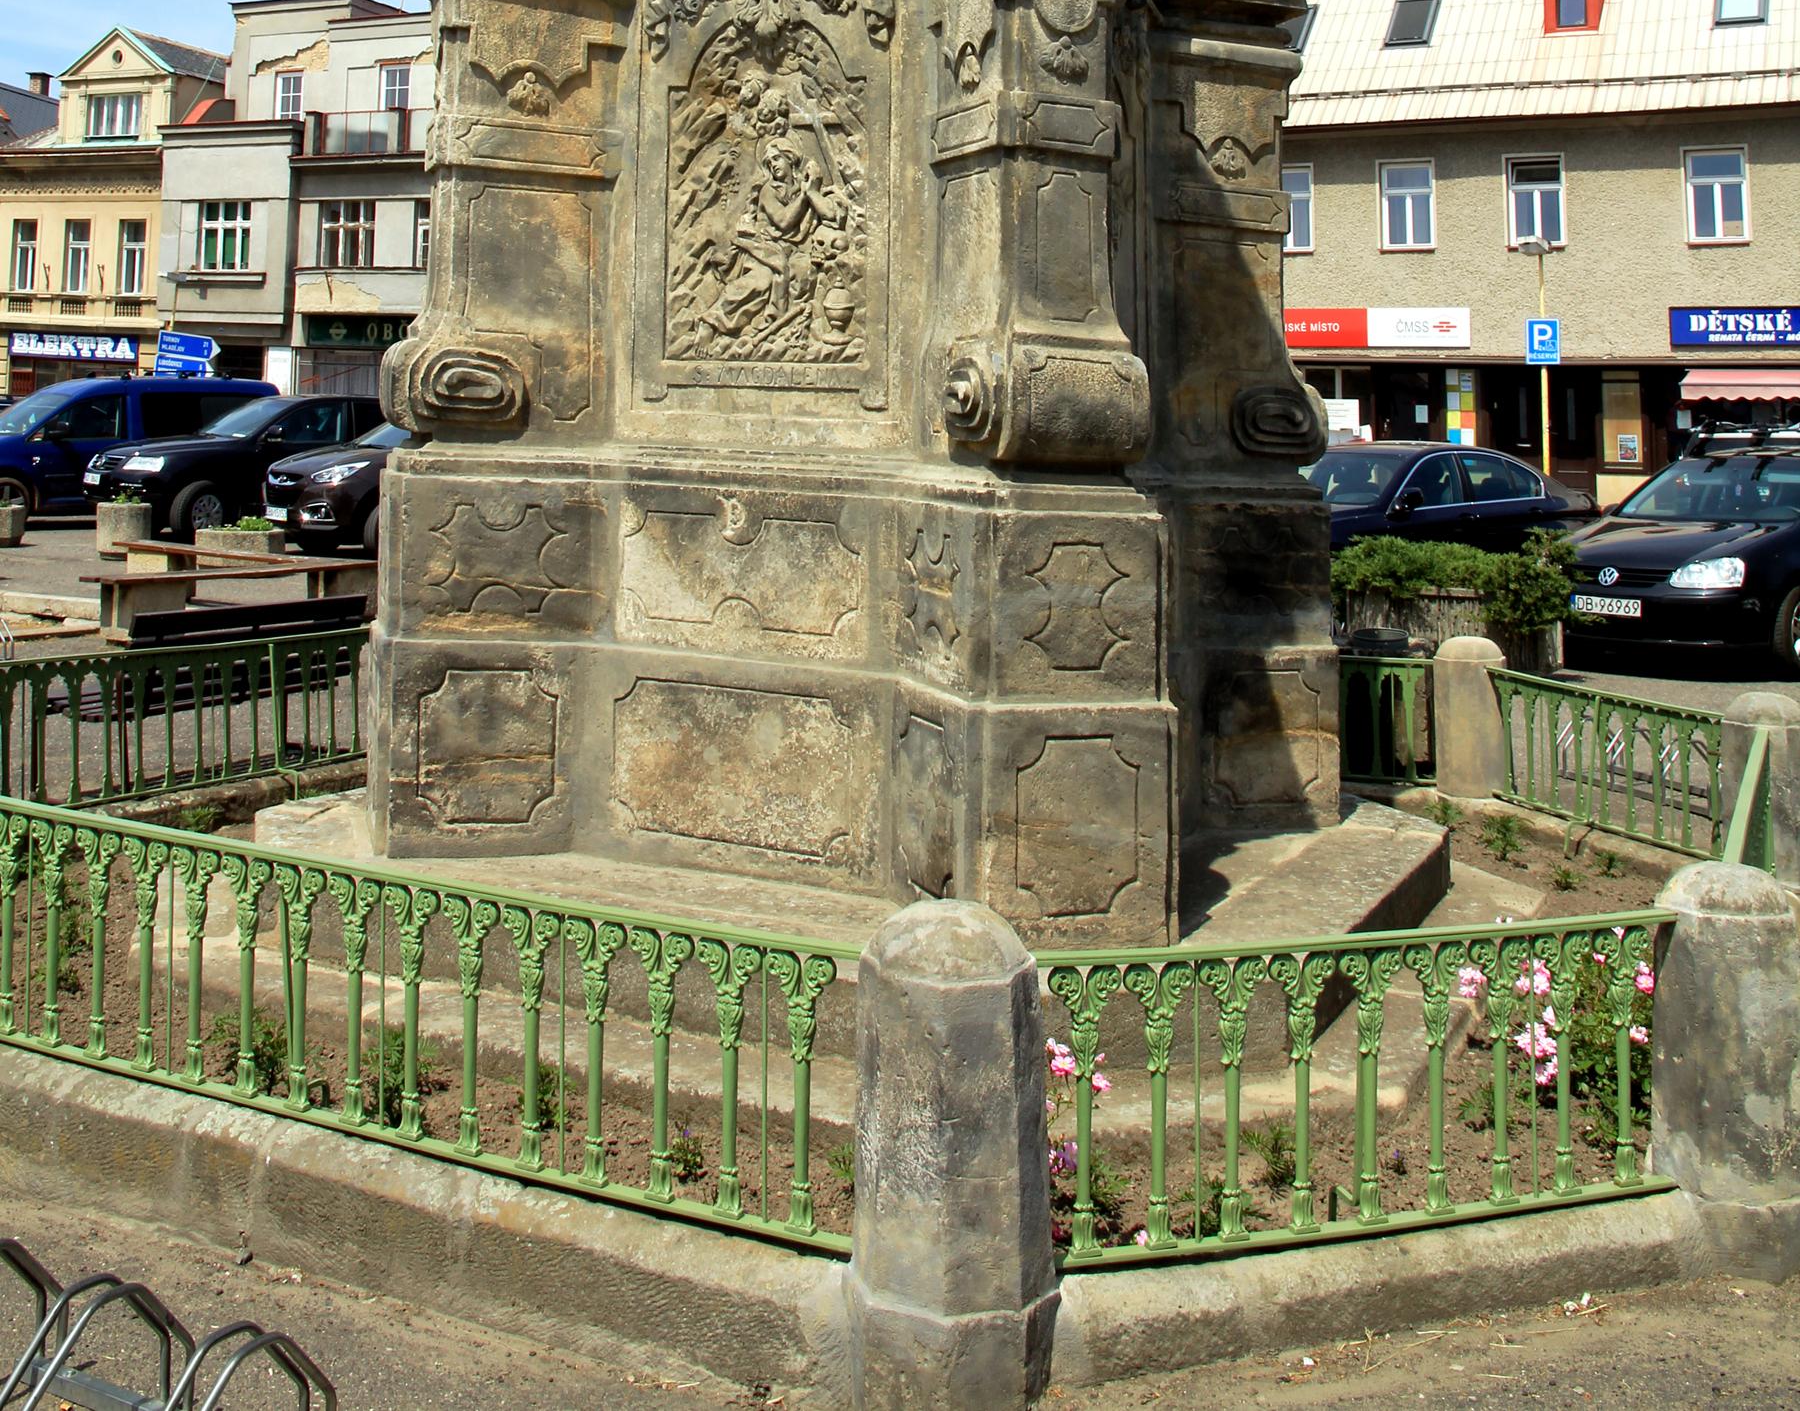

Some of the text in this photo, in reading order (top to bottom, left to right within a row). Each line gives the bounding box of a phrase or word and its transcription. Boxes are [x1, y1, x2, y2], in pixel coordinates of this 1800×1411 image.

[1285, 321, 1340, 332] SKÉ MÍSTO
[1396, 319, 1430, 333] ČMSS
[1689, 309, 1792, 331] DĚTSKÉ
[11, 332, 135, 359] ELEKTRA
[1533, 324, 1552, 350] P
[1708, 334, 1743, 342] RENATA
[1745, 331, 1776, 342] ČERNÁ
[1576, 596, 1640, 614] DB 96969
